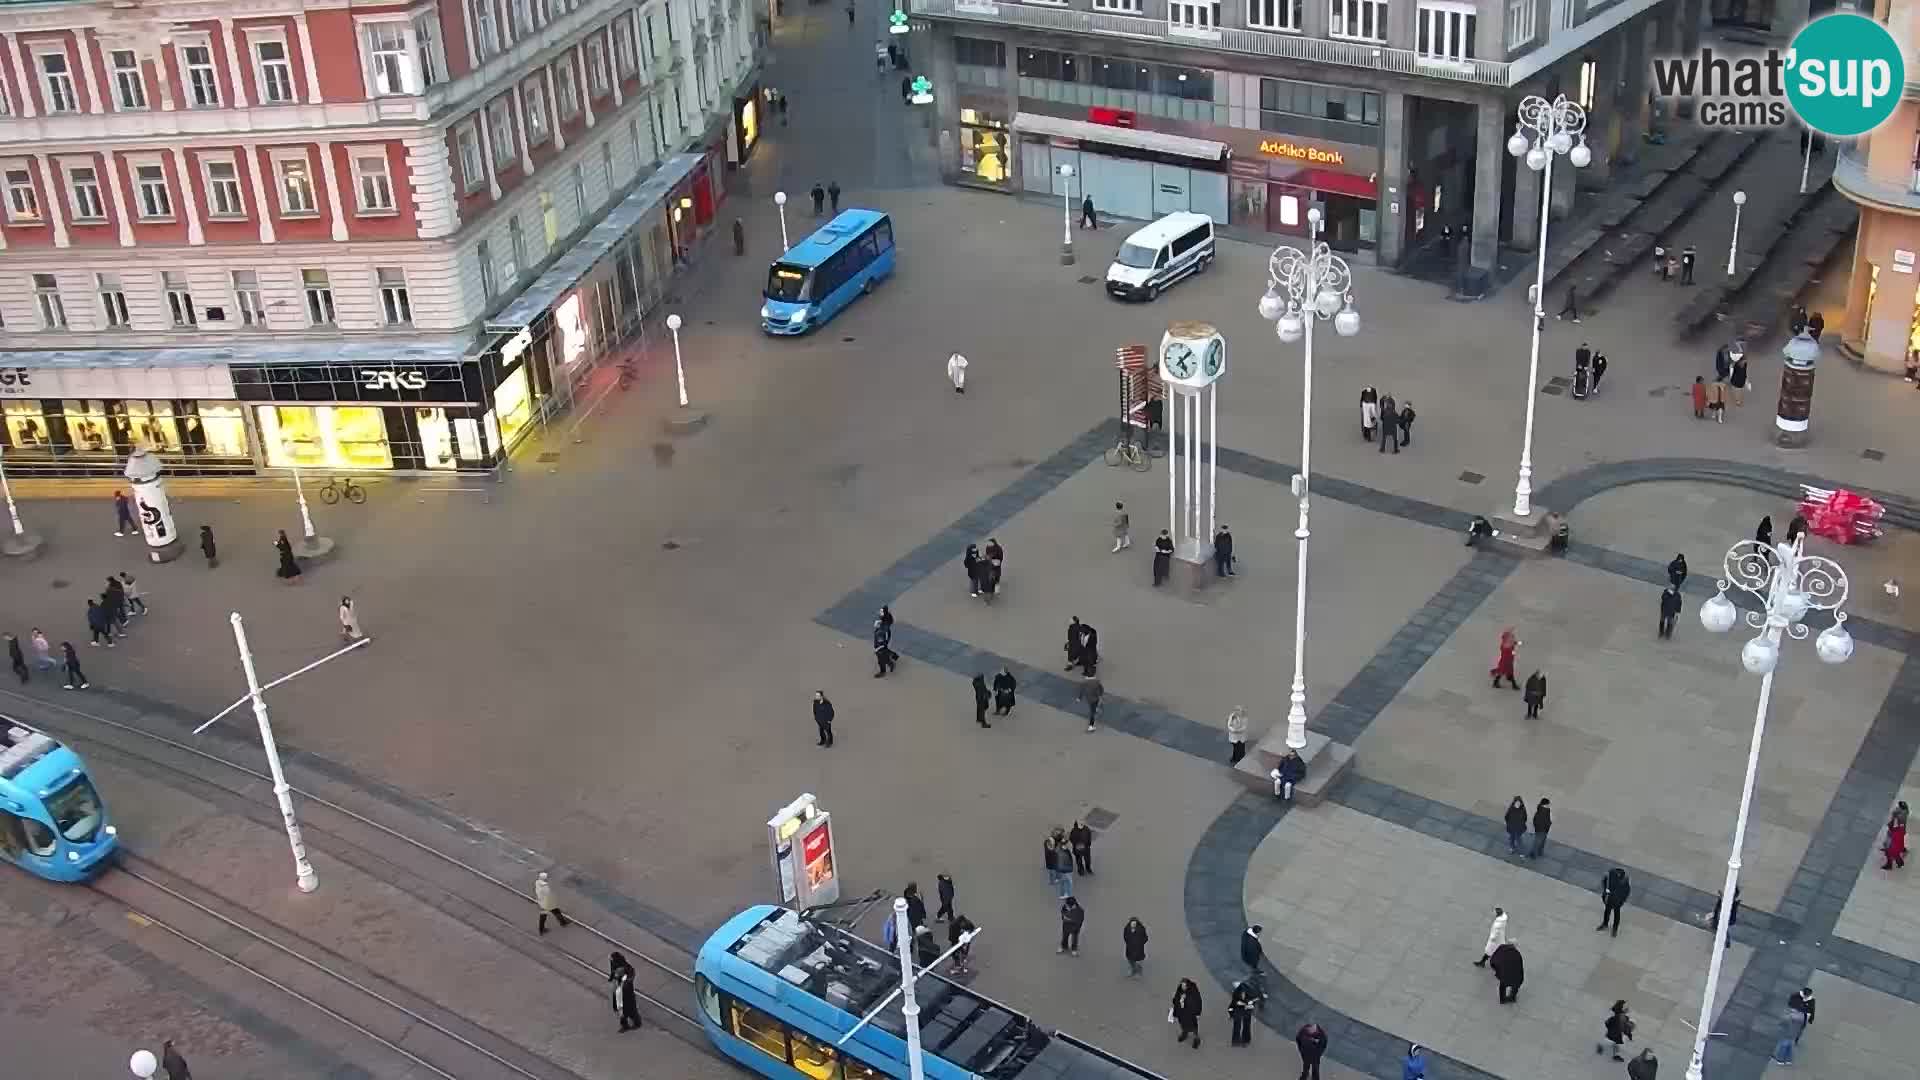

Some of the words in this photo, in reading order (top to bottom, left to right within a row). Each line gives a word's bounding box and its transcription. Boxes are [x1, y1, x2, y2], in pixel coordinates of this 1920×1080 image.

[1260, 140, 1306, 158] Addiko
[1308, 147, 1344, 164] Bank
[361, 371, 426, 389] ZAKS
